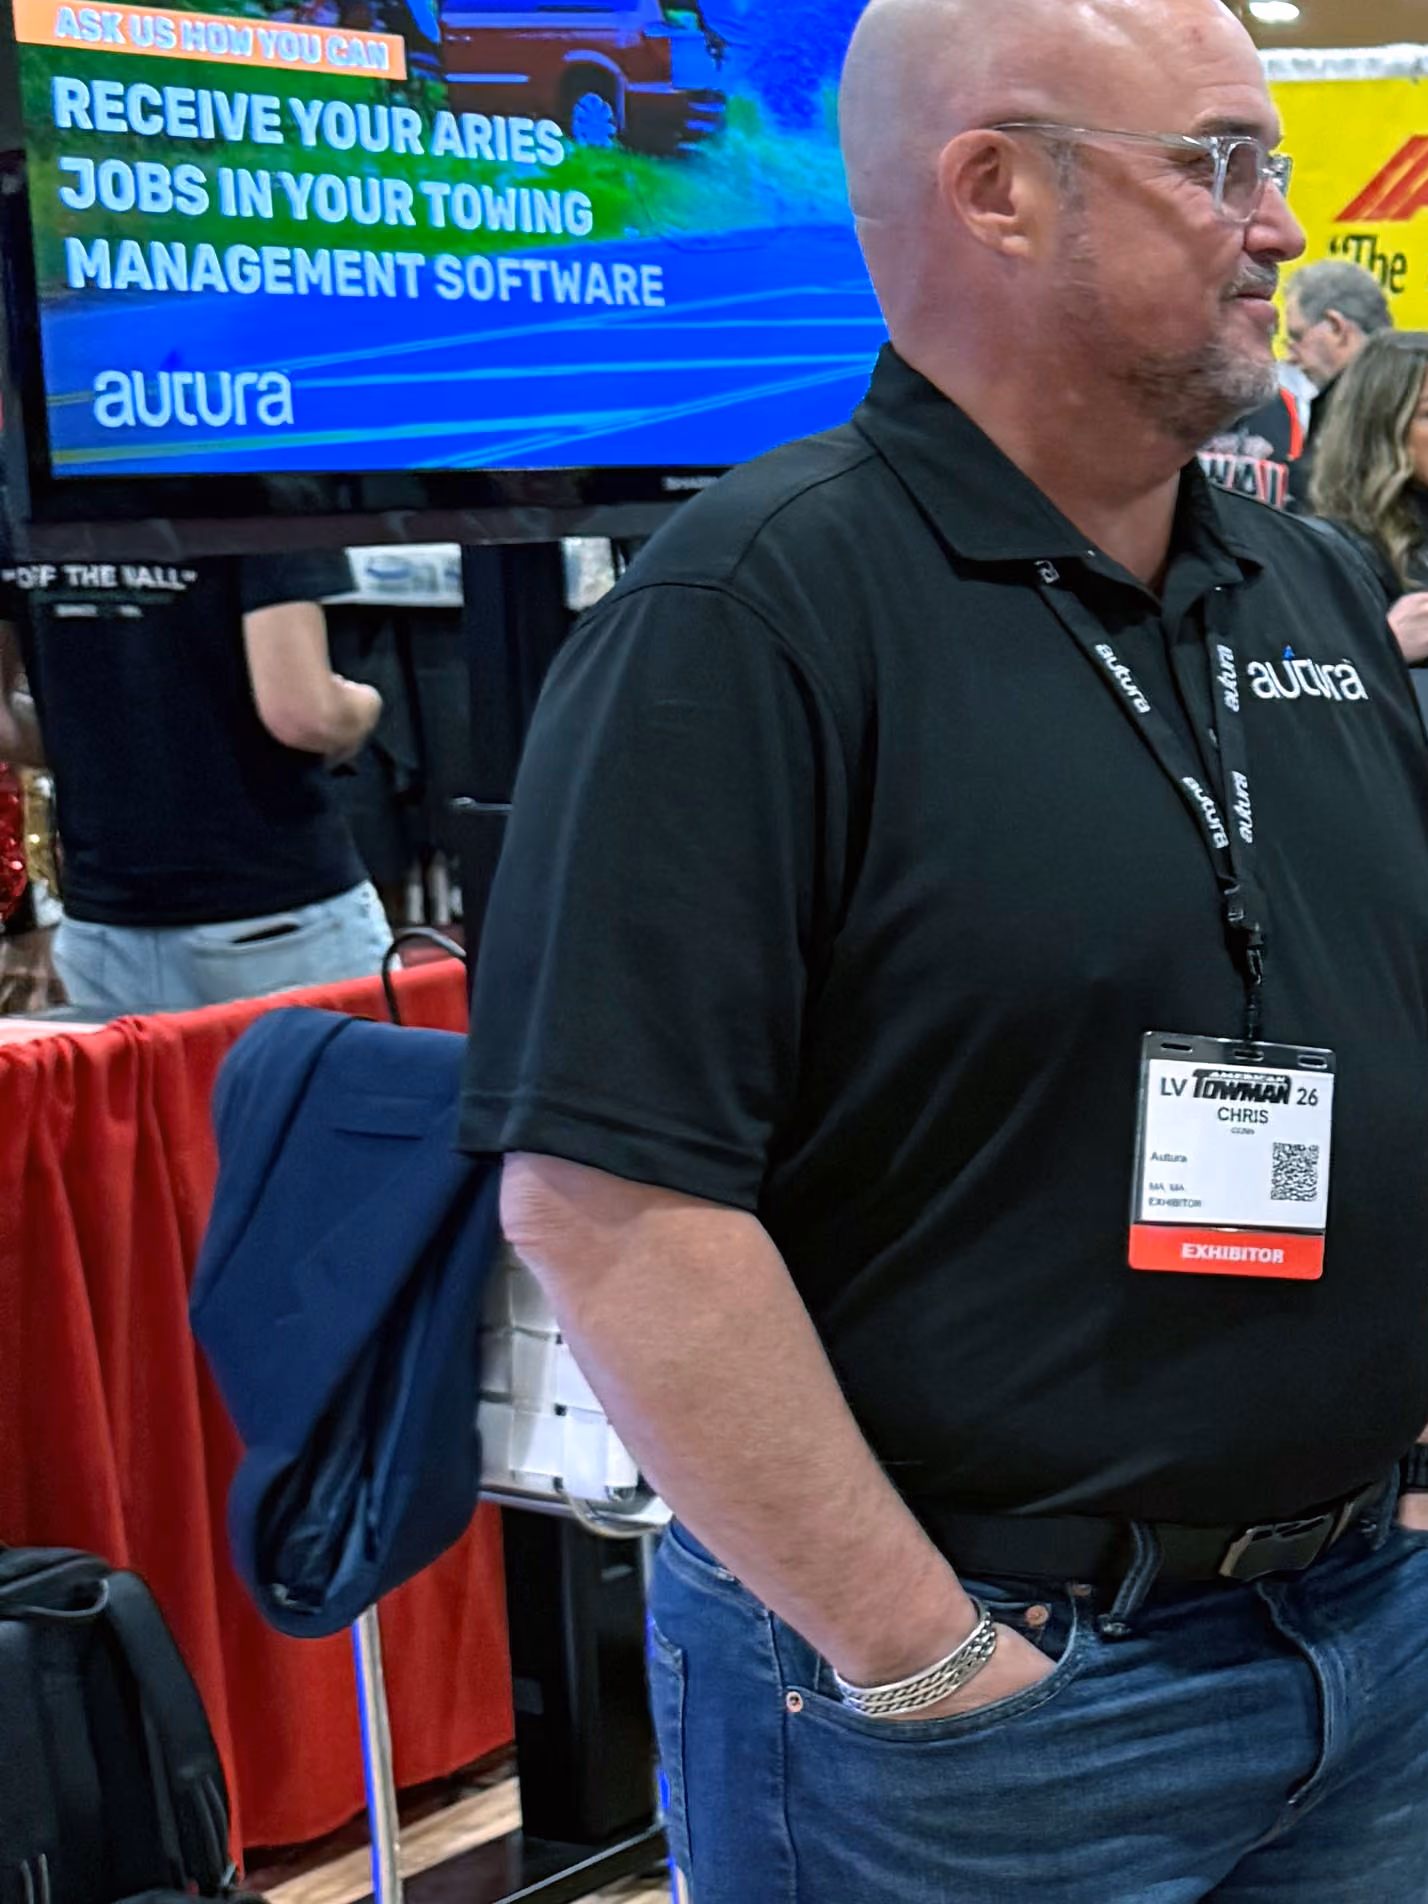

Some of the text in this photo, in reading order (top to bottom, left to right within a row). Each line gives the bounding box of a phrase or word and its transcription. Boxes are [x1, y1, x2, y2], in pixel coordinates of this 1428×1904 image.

[55, 7, 389, 70] ASK US HOW YOU CAN
[50, 76, 565, 166] RECEIVE YOUR ARIES
[57, 157, 593, 237] JOBS IN YOUR TOWING
[64, 236, 666, 308] MANAGEMENT SOFTWARE
[92, 369, 295, 429] autura
[61, 564, 118, 587] THE
[1095, 644, 1150, 713] autura
[1217, 645, 1240, 712] autura
[1248, 656, 1369, 701] autura
[1182, 776, 1229, 848] autura
[1231, 770, 1252, 844] autura
[1160, 1069, 1319, 1106] LV TOWMAN 26
[1216, 1107, 1269, 1124] CHRIS
[1181, 1242, 1284, 1264] EXHIBITOR
